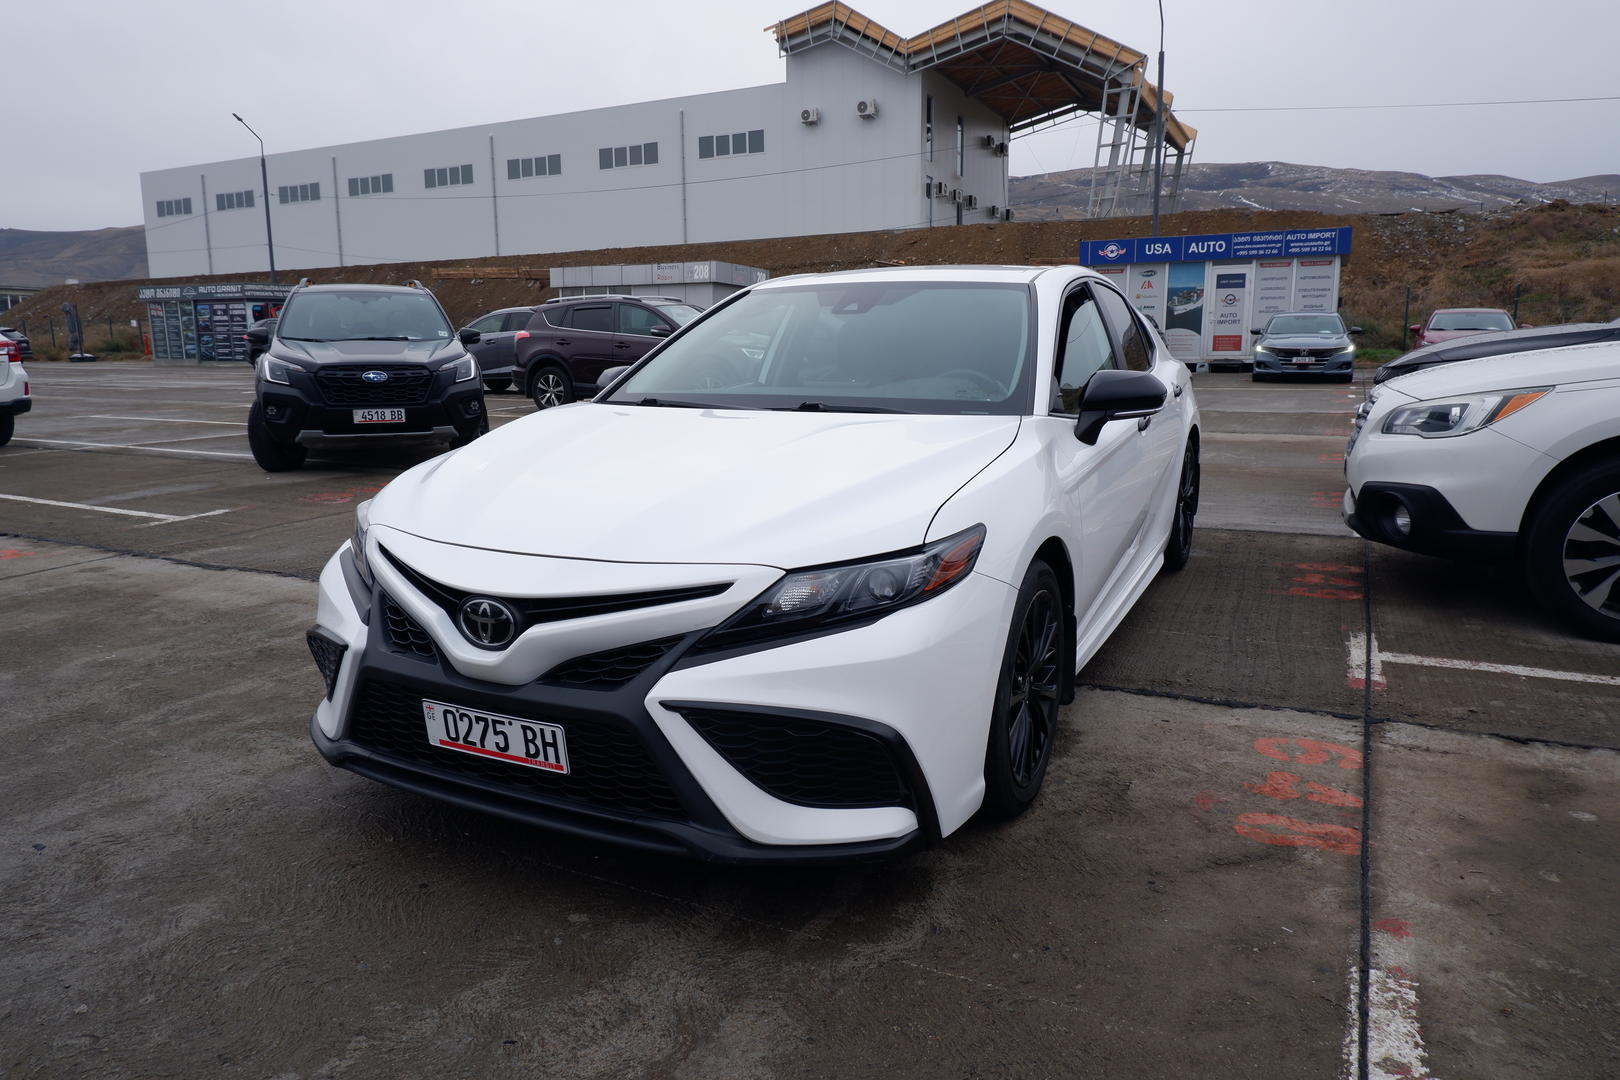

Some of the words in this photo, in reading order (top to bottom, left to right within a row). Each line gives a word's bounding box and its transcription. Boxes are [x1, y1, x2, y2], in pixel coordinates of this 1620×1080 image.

[1286, 233, 1307, 241] AUTO
[1307, 231, 1336, 239] IMPORT
[1145, 243, 1172, 255] USA
[1188, 241, 1226, 253] AUTO
[694, 264, 709, 279] 208
[216, 285, 242, 293] GRANIT
[361, 410, 386, 421] 4518
[390, 410, 403, 420] BB
[426, 711, 436, 721] GE
[443, 708, 510, 753] 0275
[520, 724, 561, 764] BH
